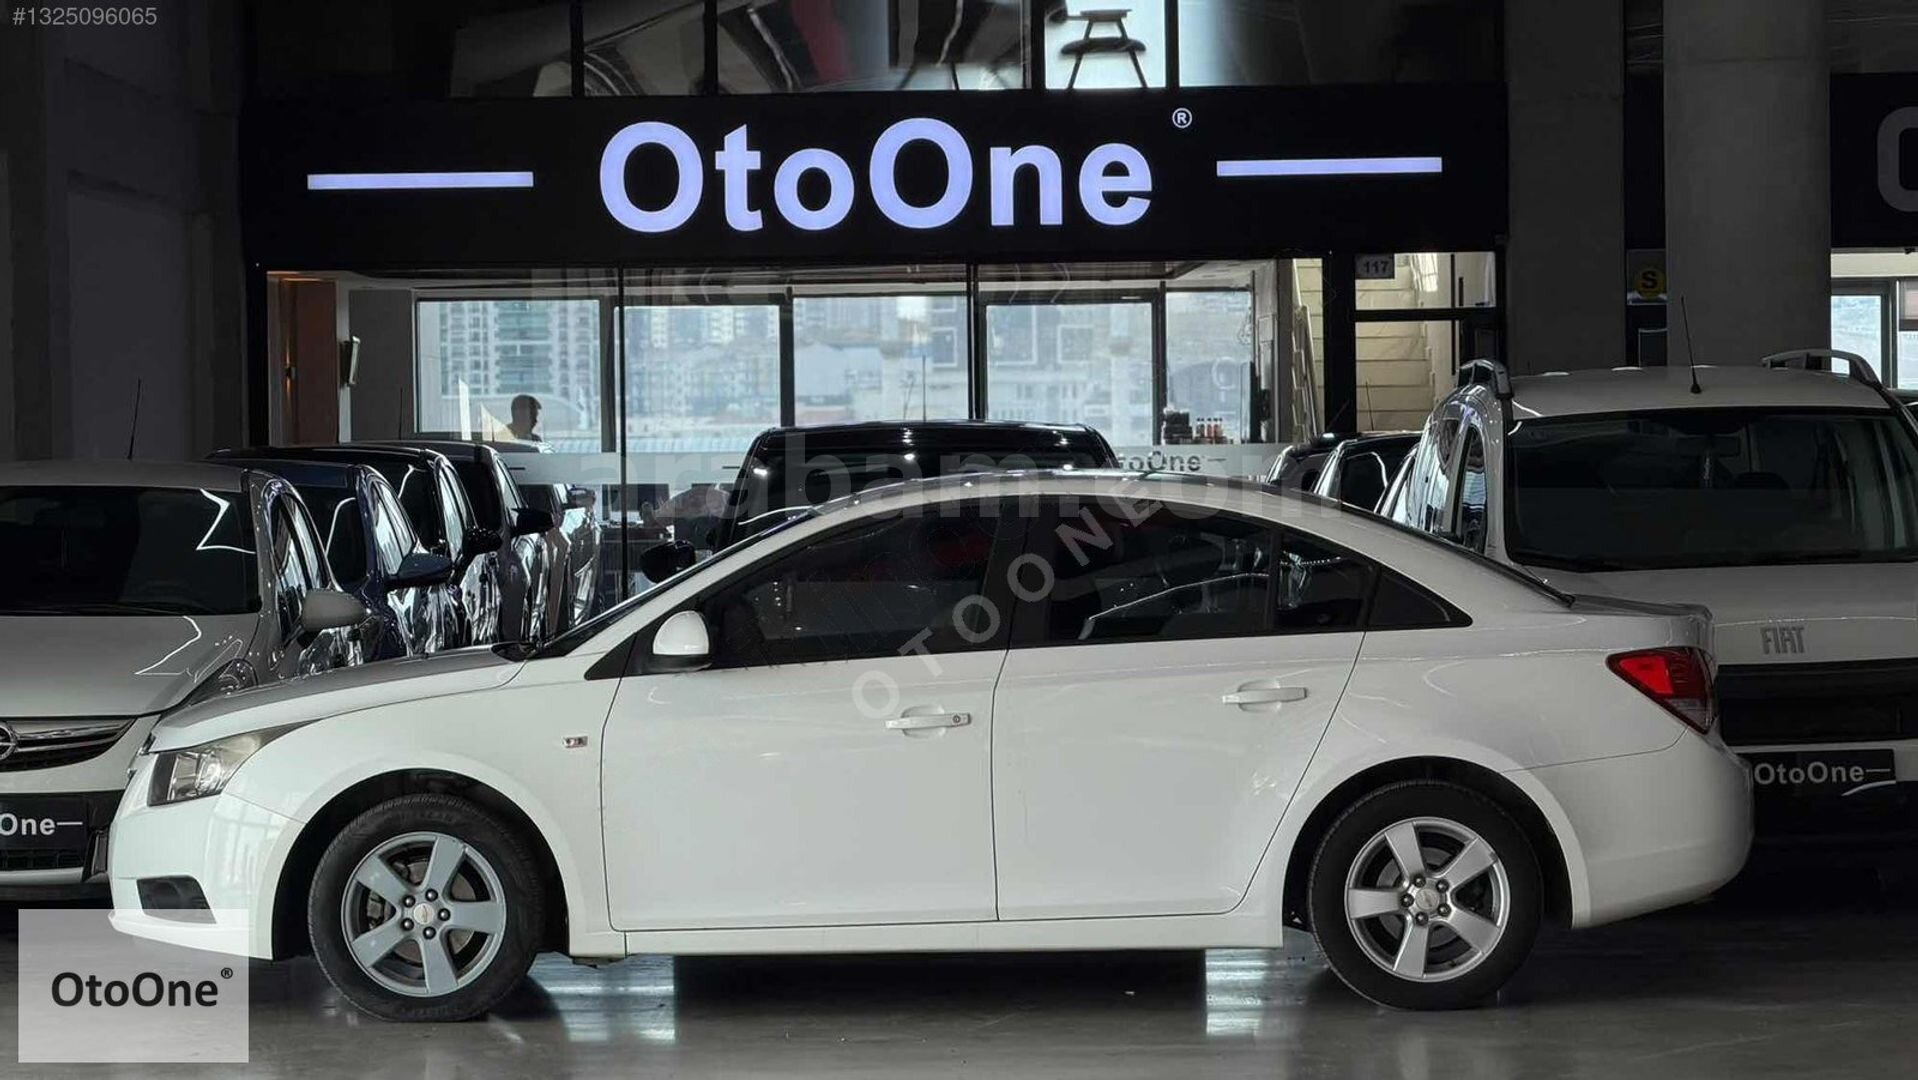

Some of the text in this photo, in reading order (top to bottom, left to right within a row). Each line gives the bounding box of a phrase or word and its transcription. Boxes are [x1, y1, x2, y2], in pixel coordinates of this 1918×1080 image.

[1363, 261, 1388, 273] 117
[1760, 627, 1804, 654] FIAT
[1754, 761, 1865, 785] OtoOne
